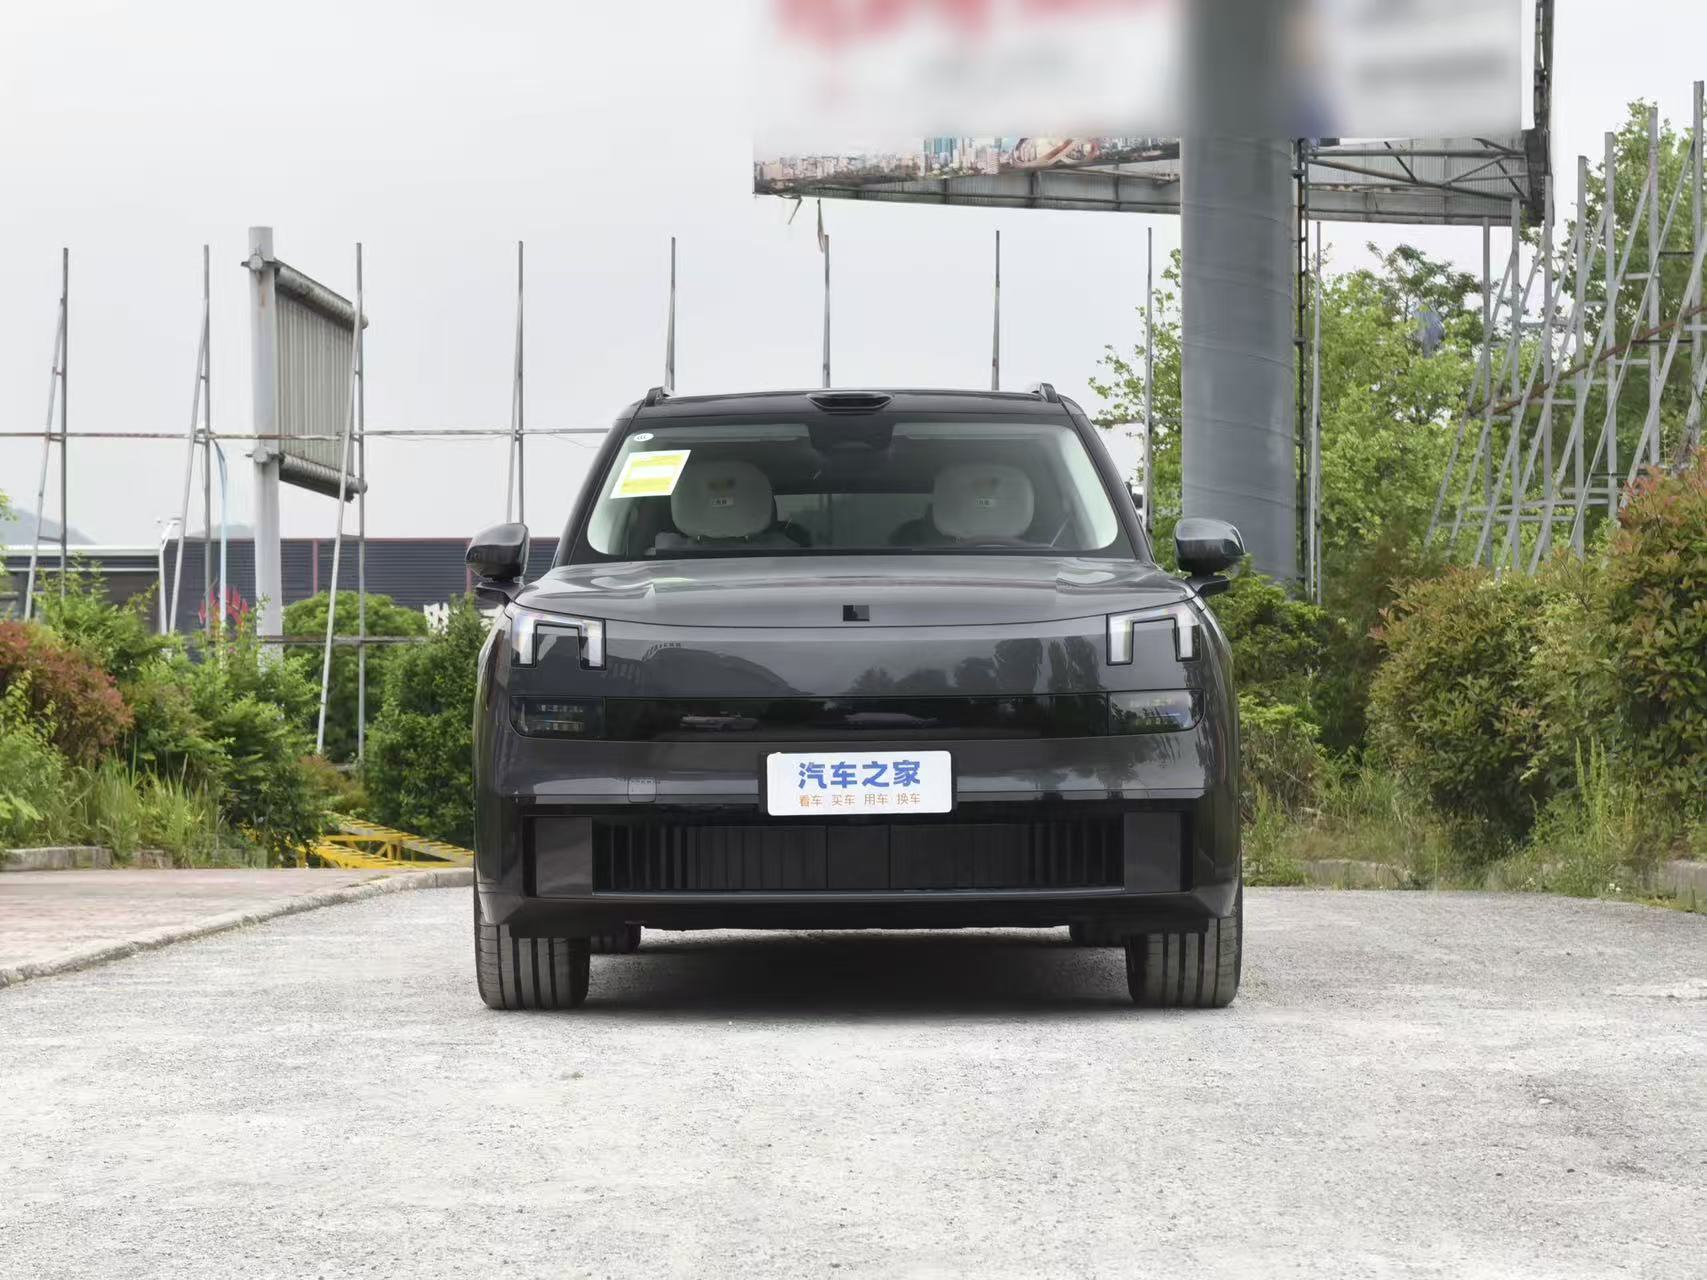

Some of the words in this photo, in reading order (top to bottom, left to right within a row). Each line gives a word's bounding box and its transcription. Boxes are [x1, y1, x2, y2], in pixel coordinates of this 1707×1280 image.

[798, 760, 921, 789] 汽车之家
[832, 794, 855, 807] 买车
[864, 793, 889, 806] 用车
[896, 792, 920, 805] 换车
